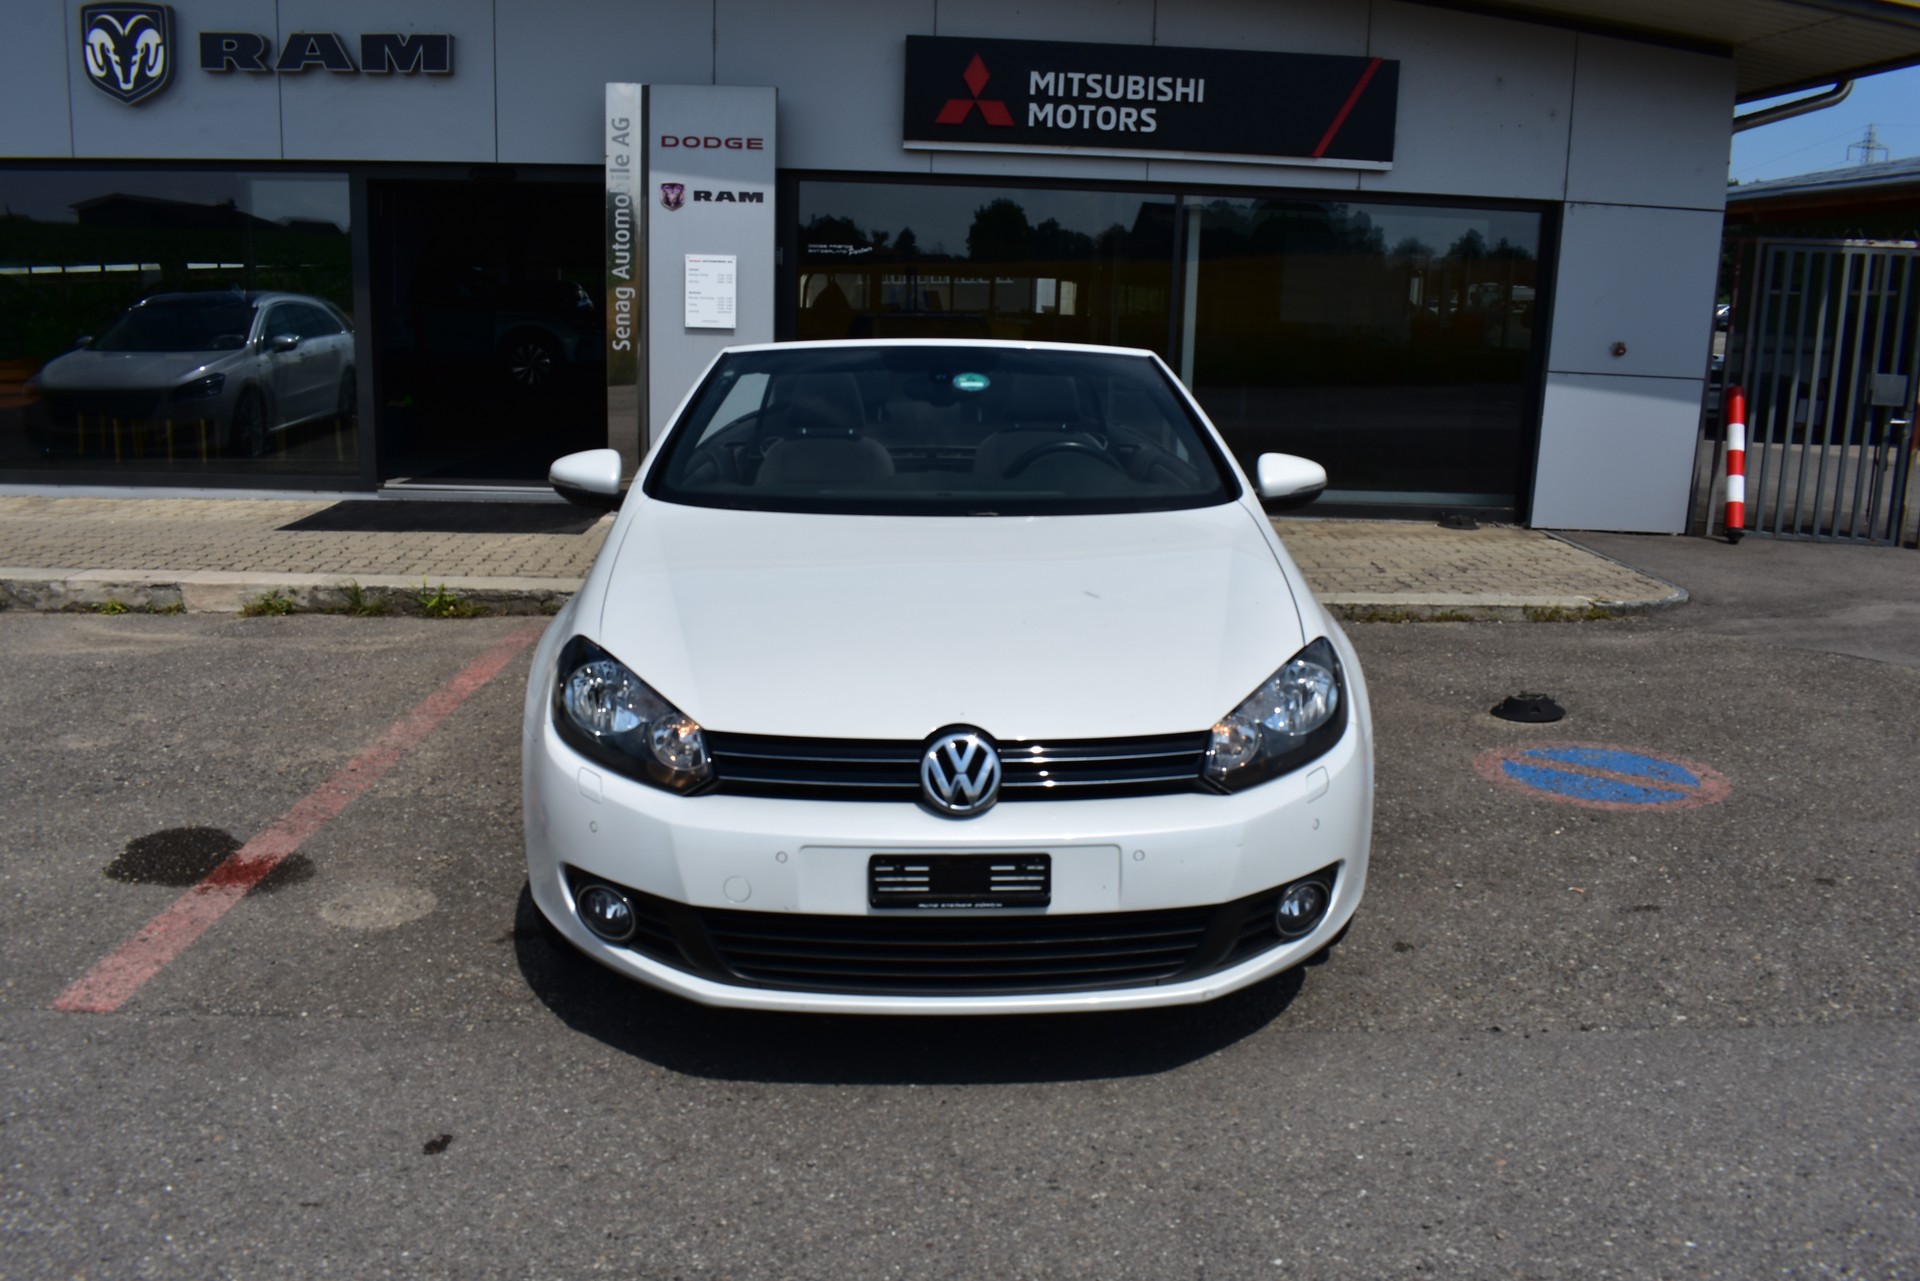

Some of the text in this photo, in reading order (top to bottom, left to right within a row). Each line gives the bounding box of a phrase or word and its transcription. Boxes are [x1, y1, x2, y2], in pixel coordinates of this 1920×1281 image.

[199, 32, 452, 74] RAM
[1029, 71, 1205, 103] MITSUBISHI
[1028, 103, 1157, 133] MOTORS
[661, 135, 763, 150] DODGE
[693, 190, 764, 203] RAM
[609, 117, 635, 351] Senag Automobile AG
[922, 733, 1000, 810] VW
